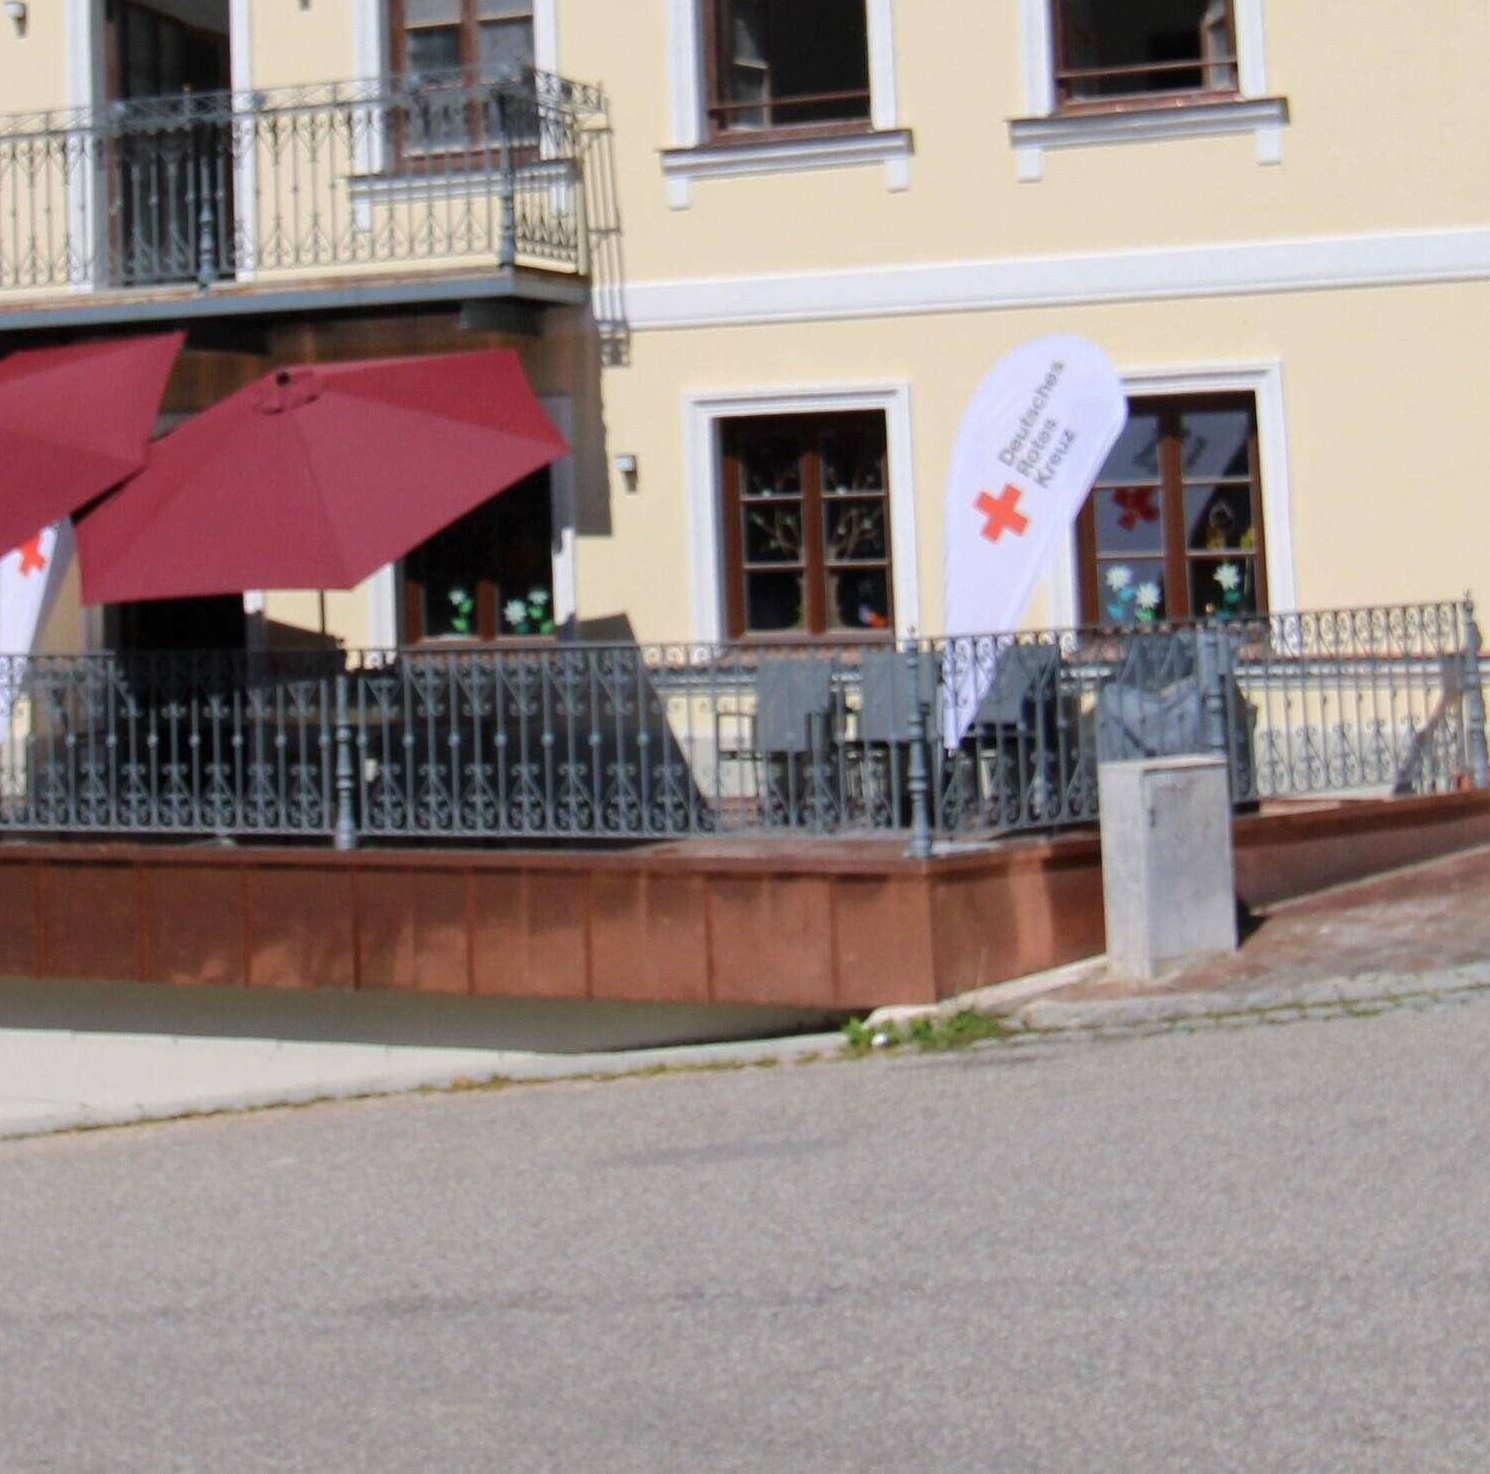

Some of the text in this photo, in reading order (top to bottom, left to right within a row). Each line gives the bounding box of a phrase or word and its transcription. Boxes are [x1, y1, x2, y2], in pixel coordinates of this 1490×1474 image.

[998, 361, 1065, 466] Deutsches
[1016, 418, 1057, 478] Rotes
[1034, 428, 1076, 488] Kreuz
